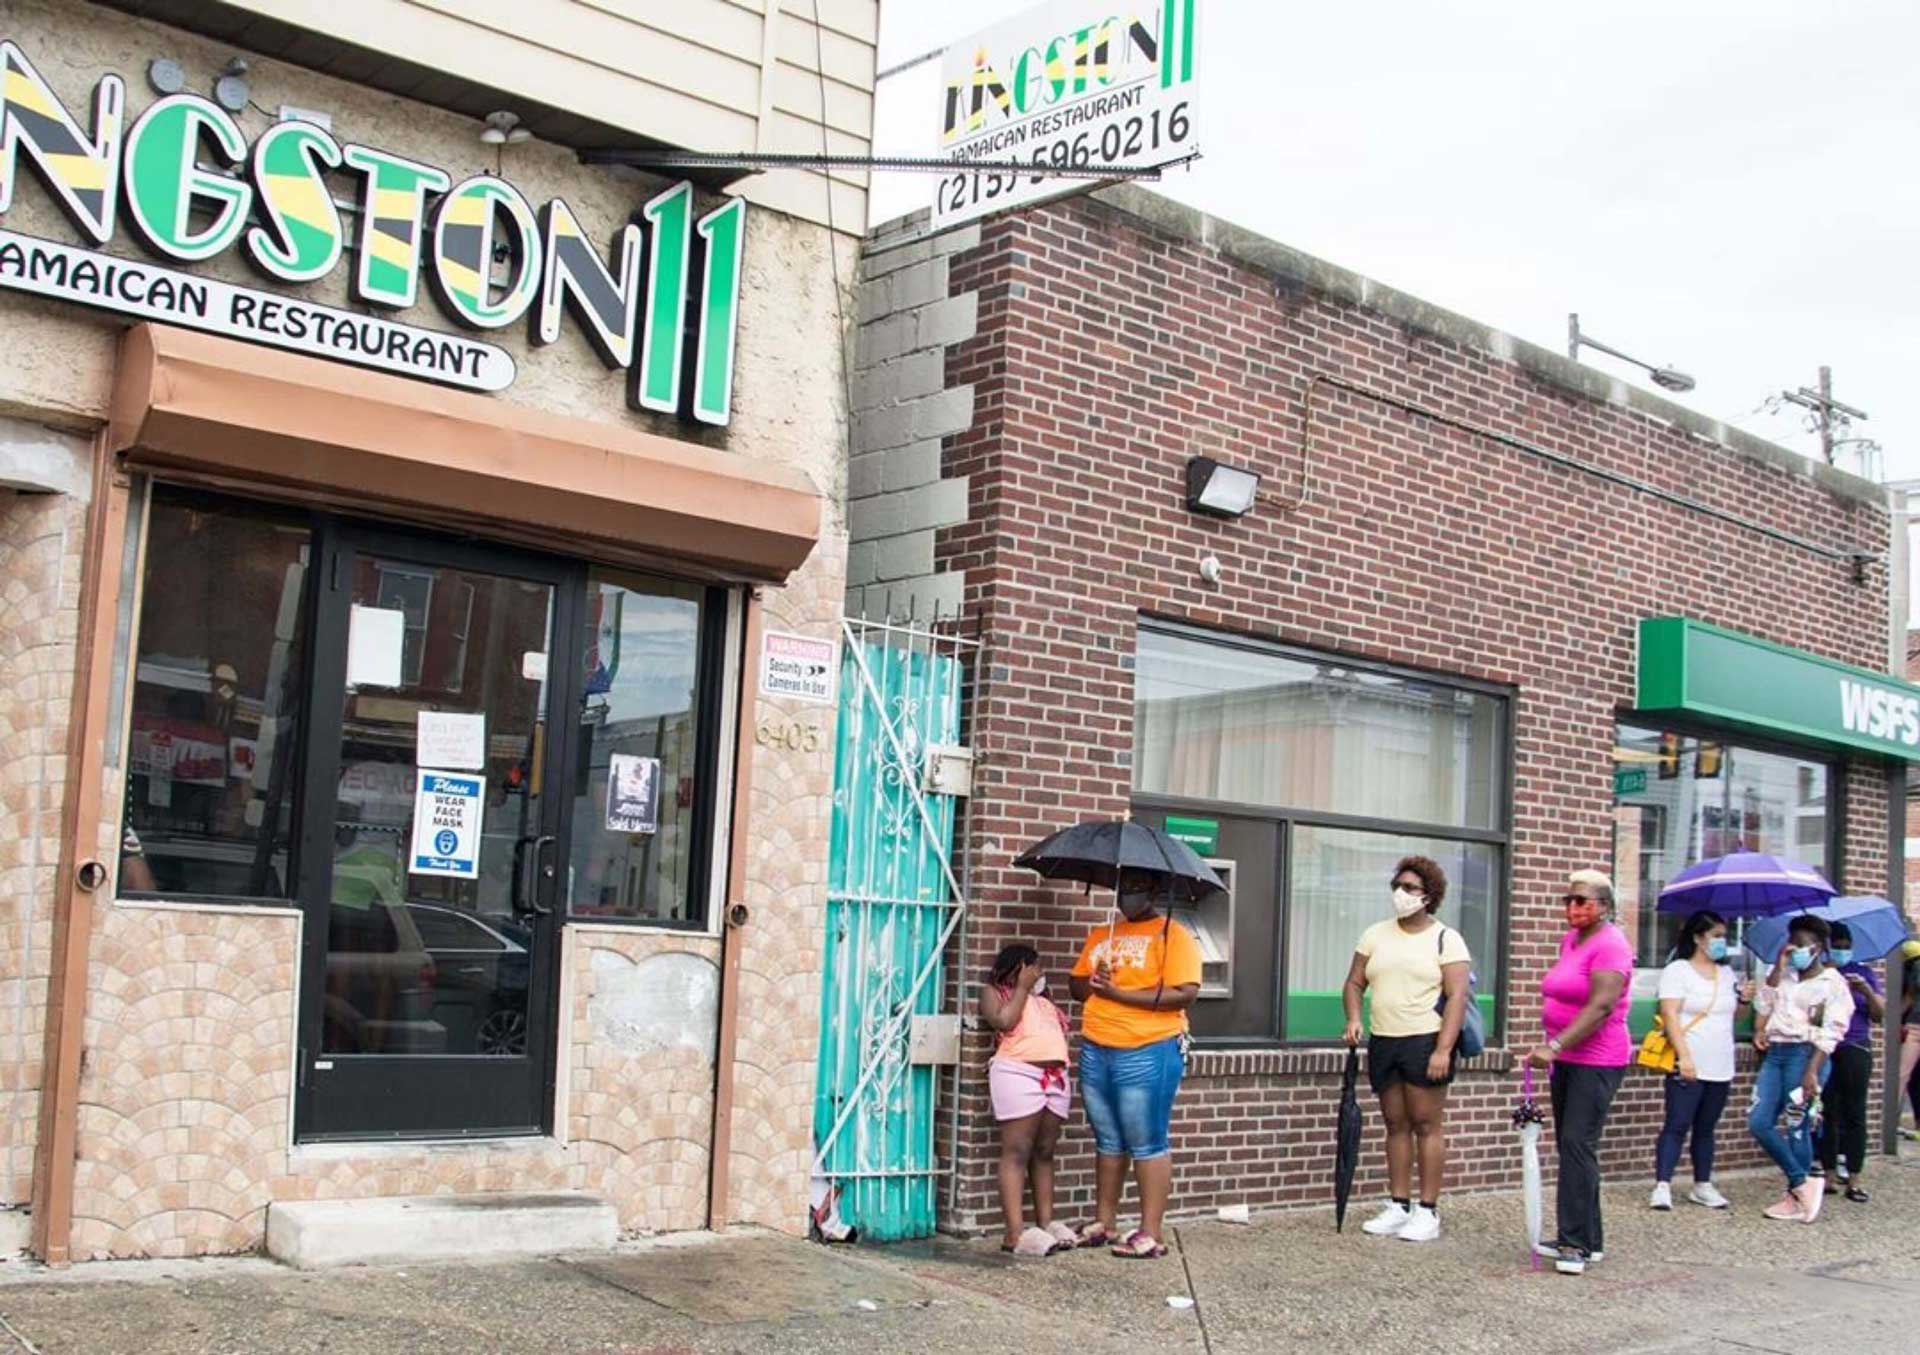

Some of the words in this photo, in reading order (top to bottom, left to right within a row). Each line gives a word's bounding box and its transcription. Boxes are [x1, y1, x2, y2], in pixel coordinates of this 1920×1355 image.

[1031, 84, 1146, 139] RESTAURANT
[0, 242, 208, 317] AMAICAN
[229, 293, 489, 378] RESTAURANT
[769, 657, 802, 677] Security
[768, 674, 801, 691] Cameras
[1840, 680, 1920, 745] WSFS
[432, 777, 470, 795] Please
[434, 795, 466, 807] WEAR
[435, 806, 463, 818] FACE
[432, 816, 464, 829] MASK
